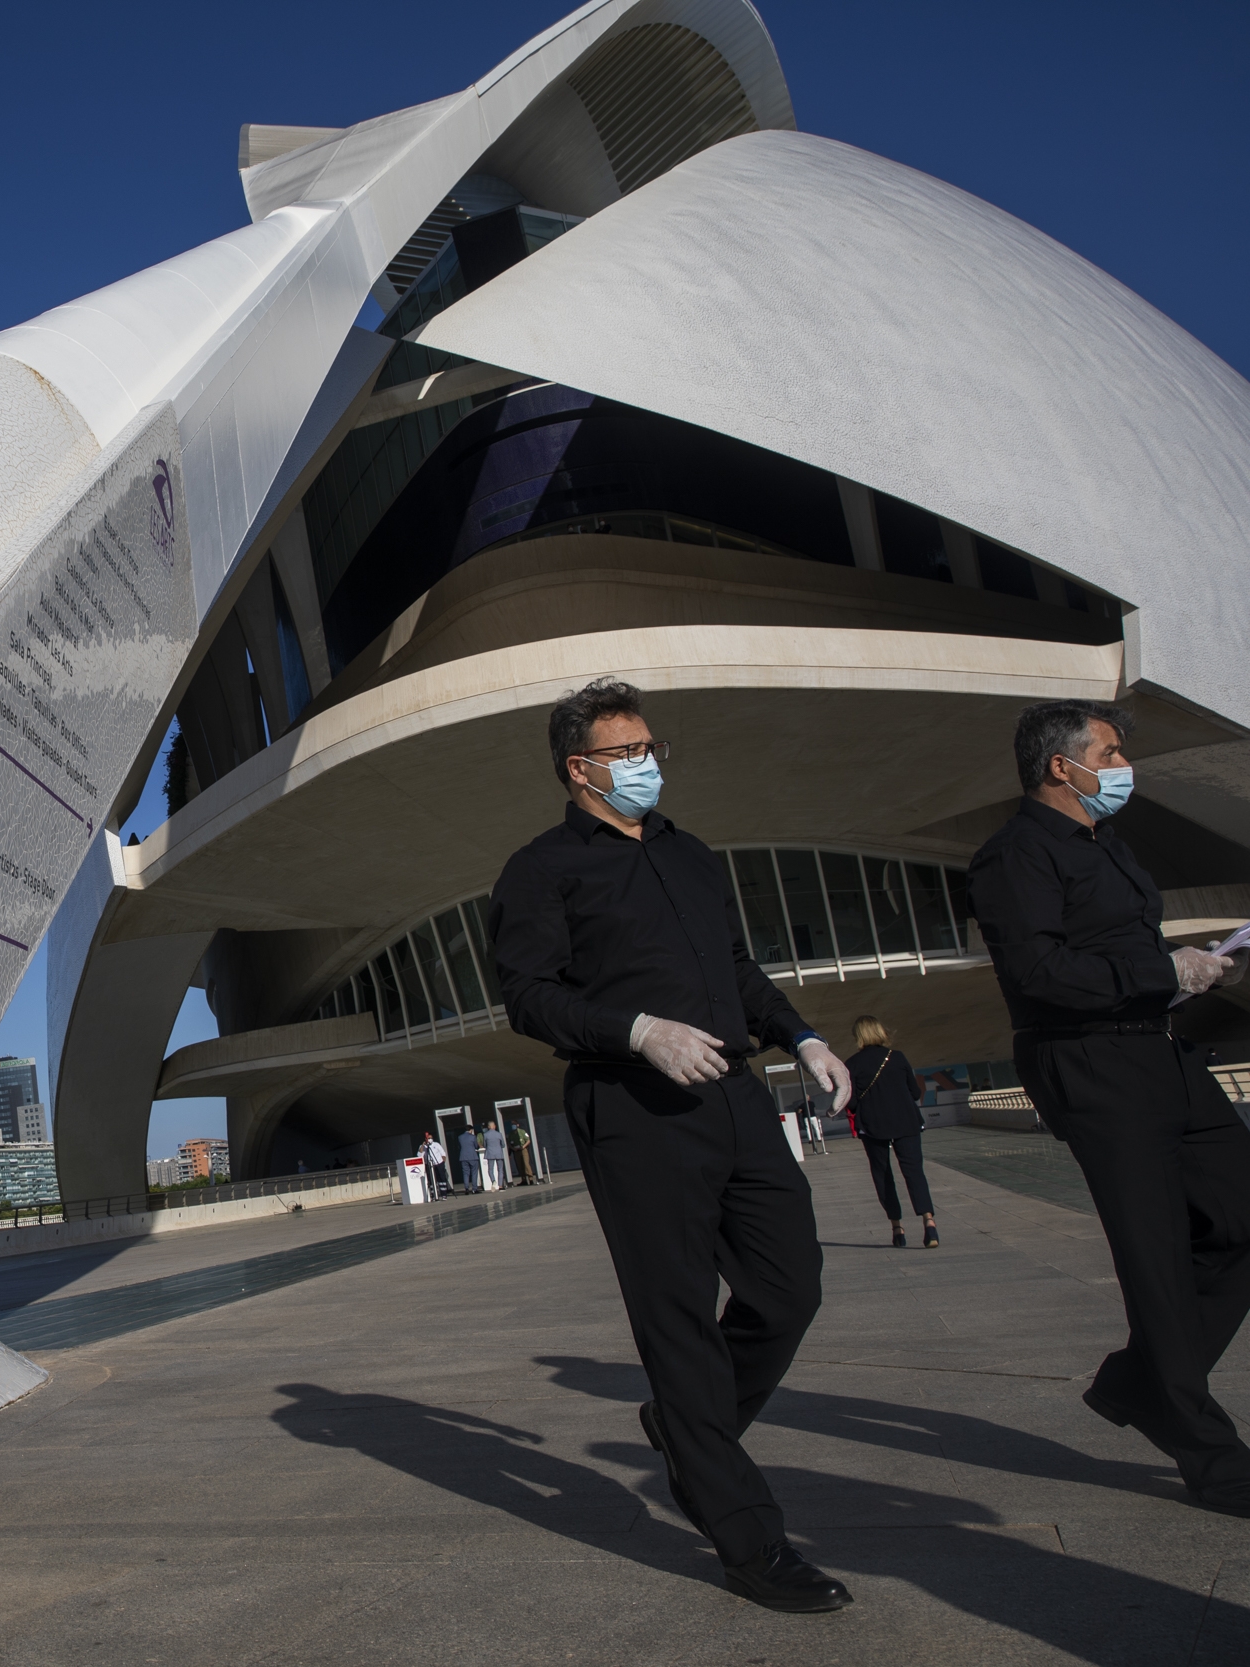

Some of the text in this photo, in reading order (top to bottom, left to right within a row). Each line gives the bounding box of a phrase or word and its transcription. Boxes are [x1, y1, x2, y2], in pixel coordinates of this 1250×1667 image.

[150, 505, 160, 546] LES
[160, 522, 175, 567] ARTS
[39, 591, 79, 651] Aula Magistral
[66, 557, 114, 630] Cafeteria La Octava
[70, 597, 77, 615] de
[78, 604, 83, 623] la
[84, 611, 94, 635] Mar
[10, 630, 52, 689] Sala Principal
[27, 610, 73, 677] Mirador Les Arts
[31, 688, 57, 729] Taquillas
[60, 719, 71, 742] Box
[22, 717, 41, 749] Visitas
[42, 740, 62, 768] guiadas
[65, 759, 83, 788] Guided
[84, 774, 98, 799] Tours
[23, 867, 41, 895] Stage
[42, 877, 56, 901] Door
